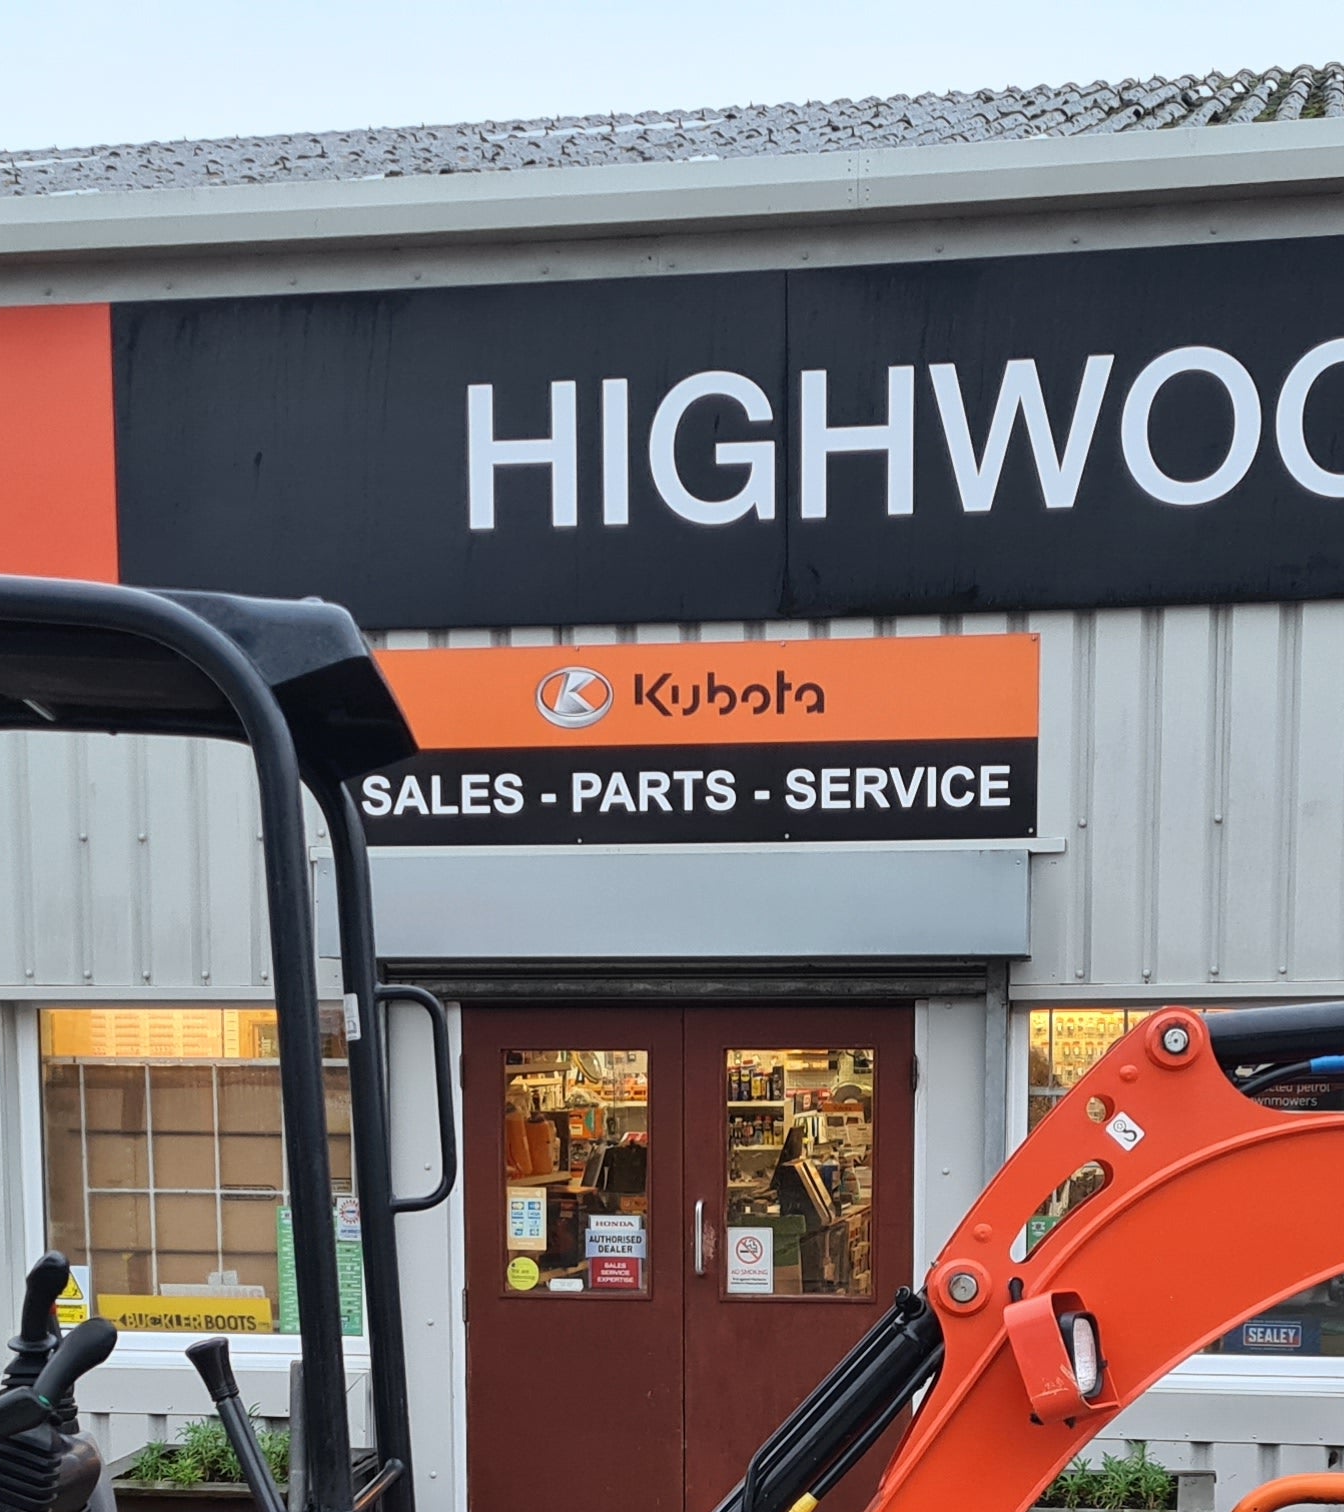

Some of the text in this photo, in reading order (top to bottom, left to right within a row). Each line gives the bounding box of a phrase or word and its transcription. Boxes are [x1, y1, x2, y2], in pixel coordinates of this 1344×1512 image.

[634, 669, 825, 717] Kubota
[360, 772, 525, 817] SALES
[572, 769, 738, 814] PARTS
[784, 764, 1012, 811] SERVICE
[1251, 1096, 1318, 1107] wnmowers
[595, 1220, 635, 1228] HONDA
[588, 1235, 643, 1244] AUTHORISED
[597, 1245, 633, 1254] DEALER
[126, 1312, 257, 1331] BUCKLER BOOTS
[1248, 1327, 1297, 1344] SEALEY
